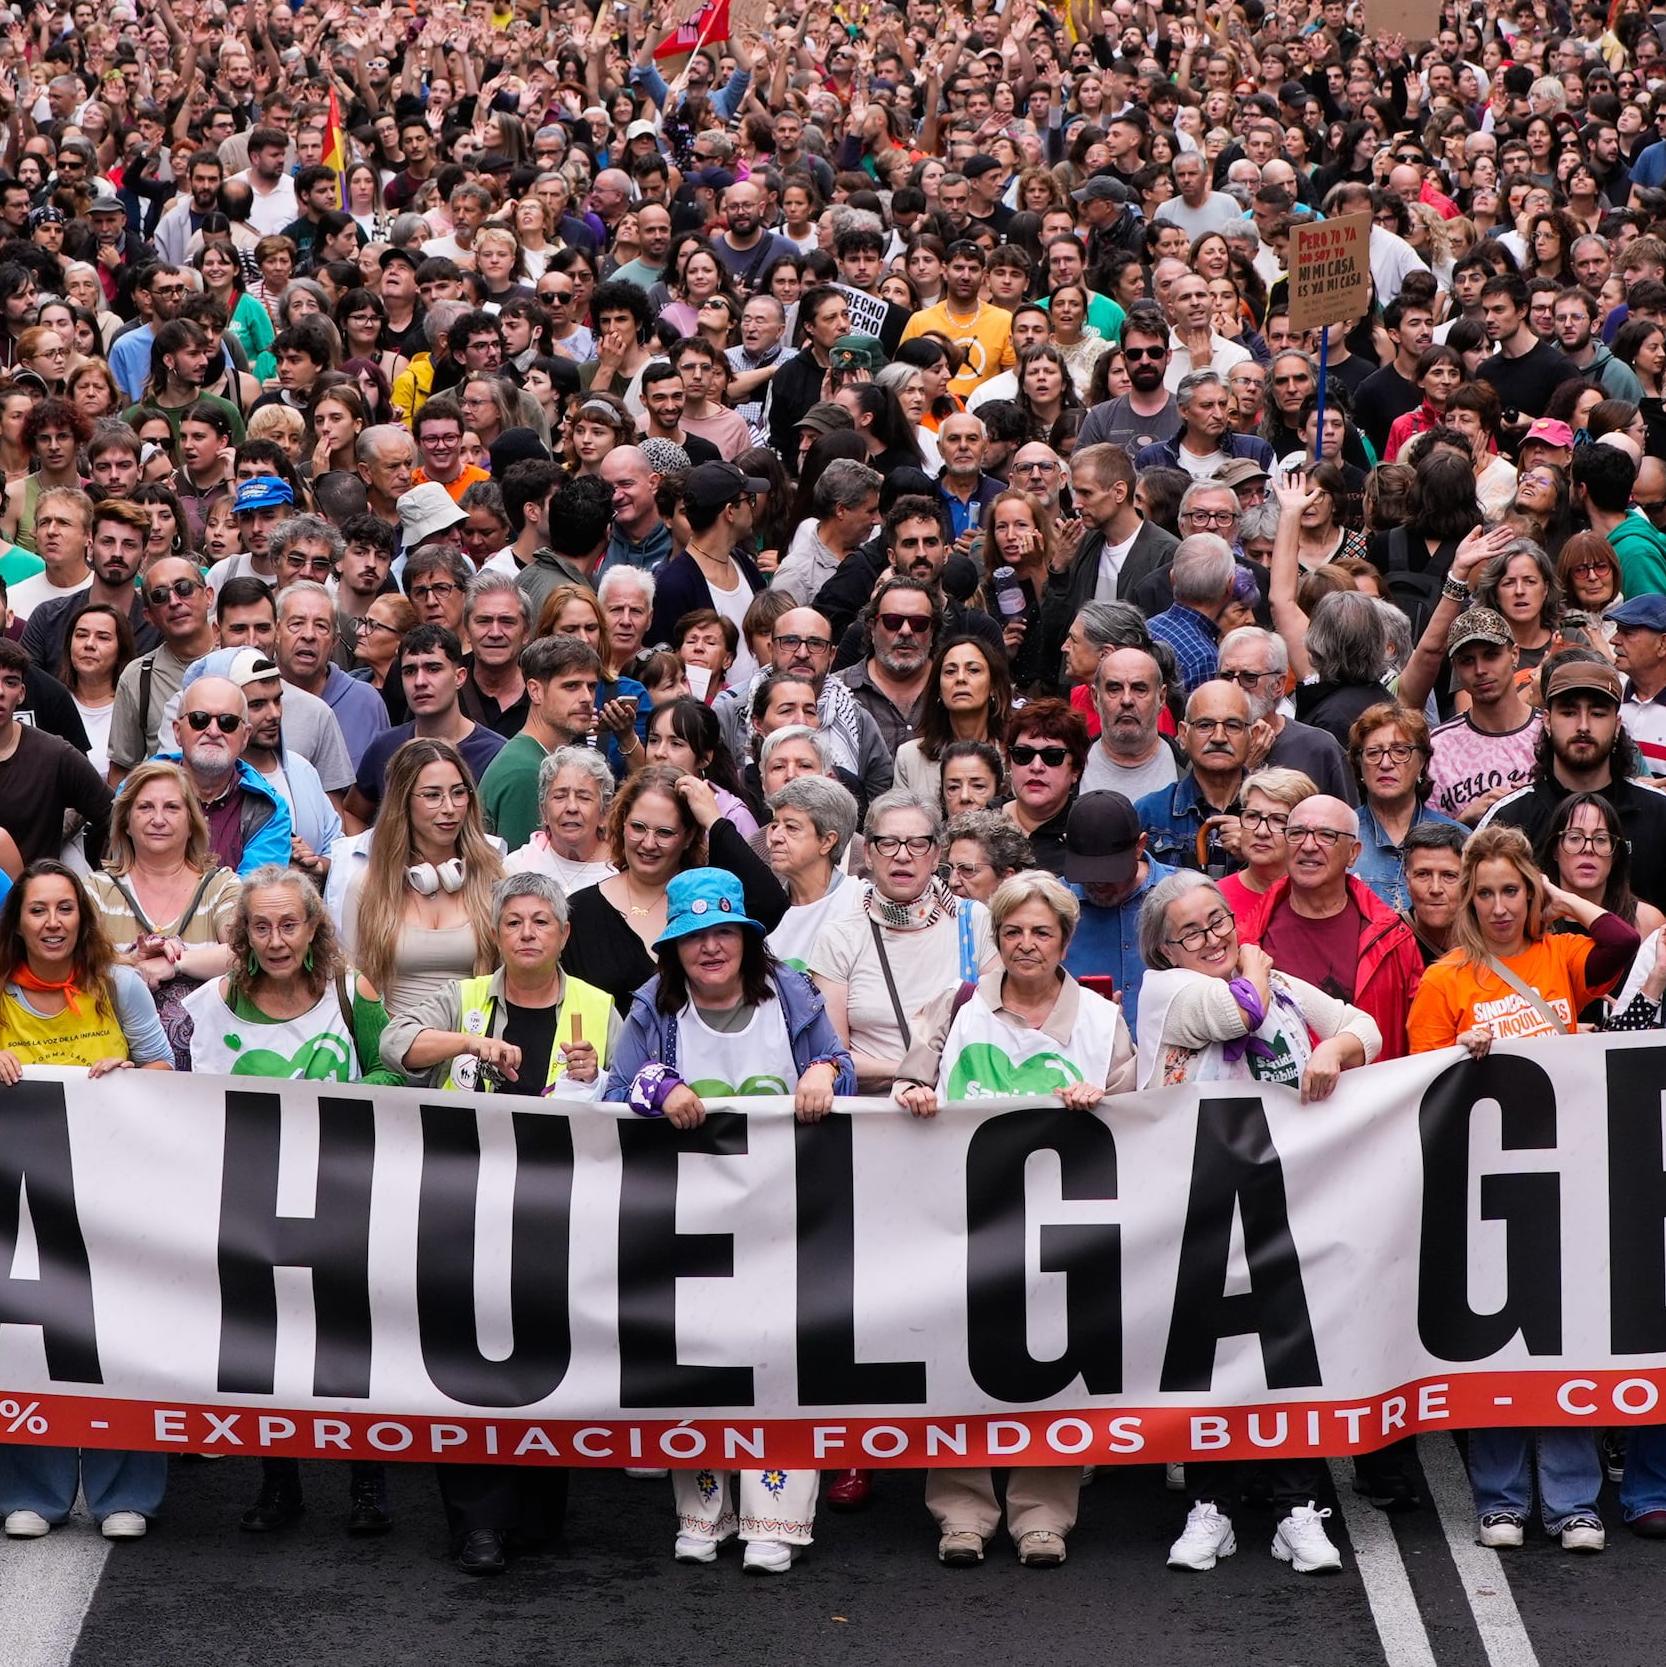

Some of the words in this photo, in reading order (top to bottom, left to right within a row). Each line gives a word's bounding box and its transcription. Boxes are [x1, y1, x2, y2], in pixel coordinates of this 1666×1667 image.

[1298, 230, 1328, 252] PERO
[1330, 228, 1341, 242] YO
[1344, 226, 1357, 243] YA
[1298, 252, 1313, 265] NO
[1314, 250, 1331, 262] SOY
[1334, 247, 1345, 258] YO
[1298, 266, 1310, 282] NI
[1312, 264, 1325, 281] MI
[1327, 256, 1355, 277] CASA
[1298, 284, 1308, 297] ES
[1312, 280, 1324, 296] YA
[1327, 277, 1338, 292] MI
[1340, 272, 1361, 289] CASA
[1440, 770, 1503, 812] HELLO
[43, 1037, 59, 1045] VOZ
[60, 1036, 69, 1044] DE
[70, 1035, 79, 1043] LA
[80, 1029, 111, 1040] INFANCIA
[217, 1090, 1324, 1409] HUELGA
[153, 1408, 767, 1461] EXPROPIACIÓN
[814, 1414, 1145, 1461] FONDOS
[1189, 1382, 1451, 1452] BUITRE
